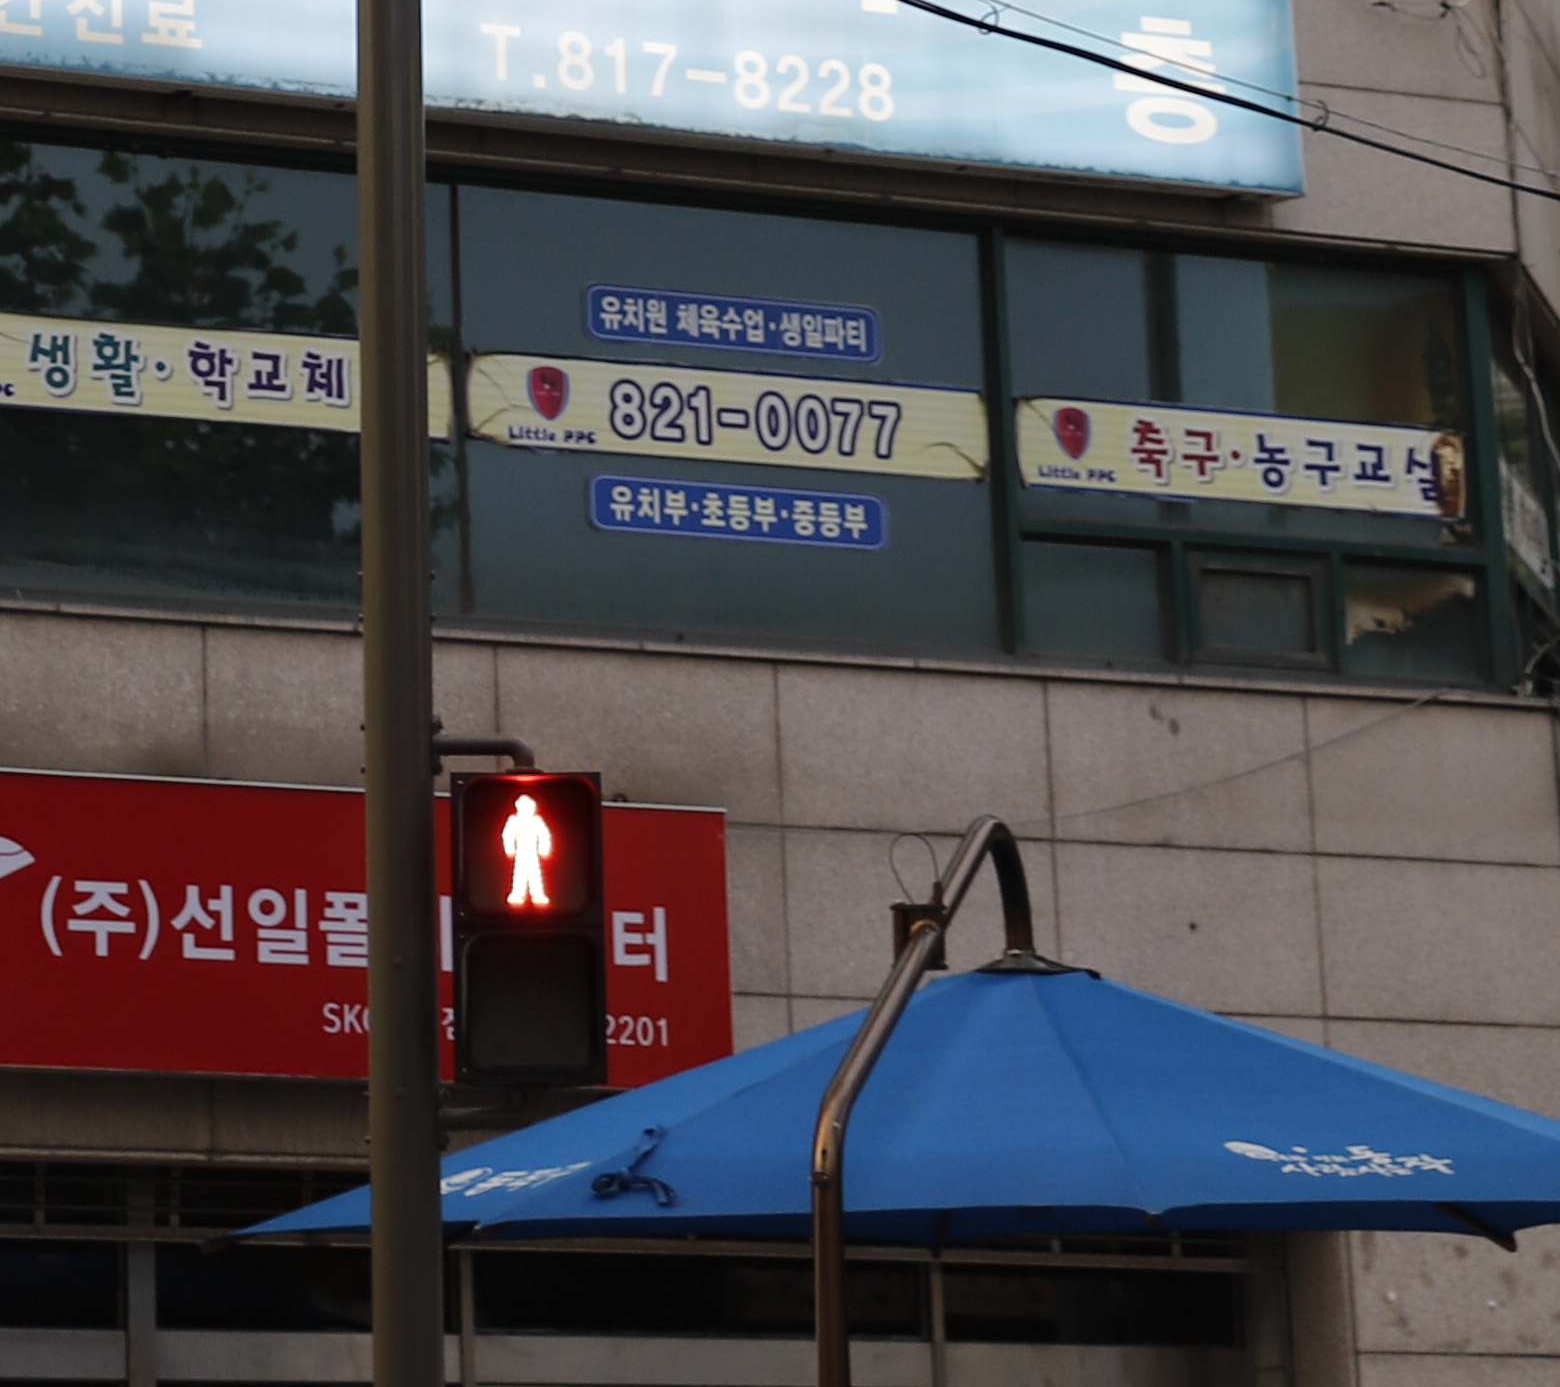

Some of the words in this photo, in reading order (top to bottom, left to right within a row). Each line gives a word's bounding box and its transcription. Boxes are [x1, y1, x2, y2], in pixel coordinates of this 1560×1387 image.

[481, 20, 897, 124] T.817-8228
[599, 295, 668, 334] 유치원
[29, 333, 346, 401] 생활·학교체
[609, 378, 903, 459] 821-0077
